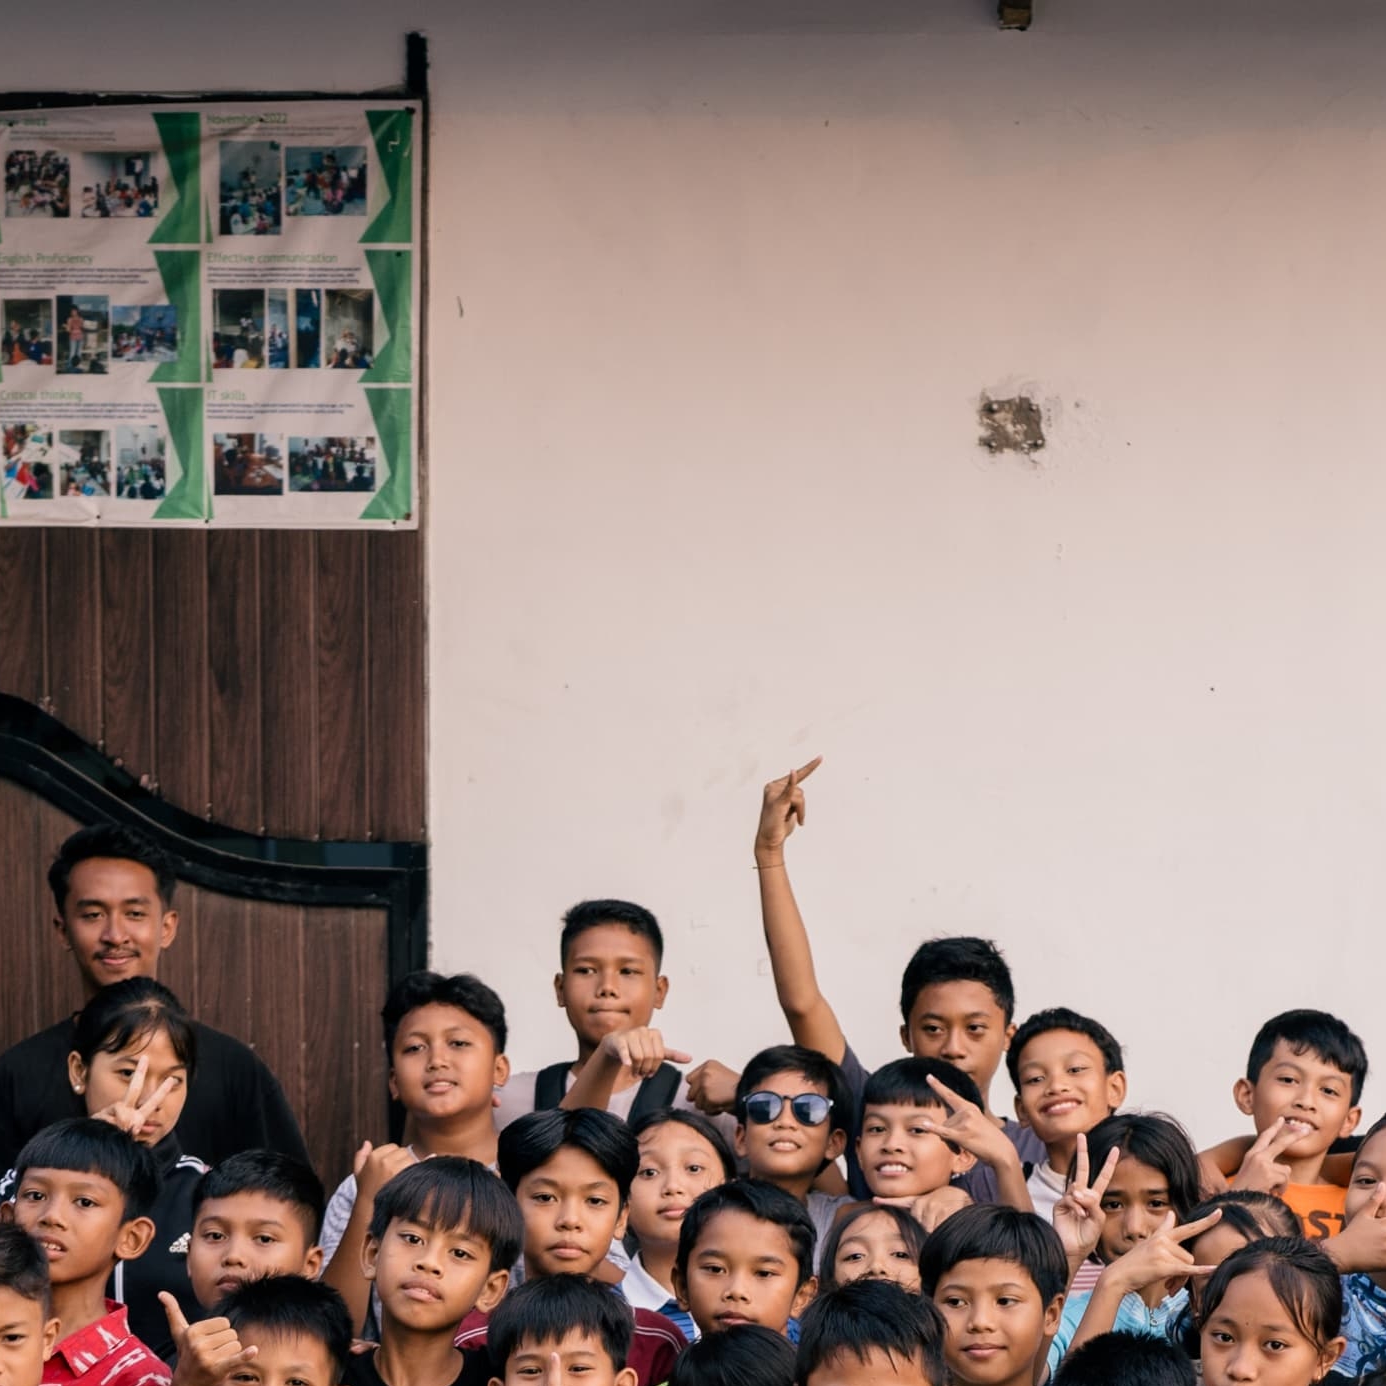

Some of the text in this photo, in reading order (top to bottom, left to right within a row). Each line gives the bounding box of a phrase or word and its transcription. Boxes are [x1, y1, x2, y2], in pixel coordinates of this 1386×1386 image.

[36, 253, 93, 265] Proficiency
[207, 252, 338, 263] Effective communication
[40, 390, 83, 402] thinking
[220, 390, 246, 400] skills
